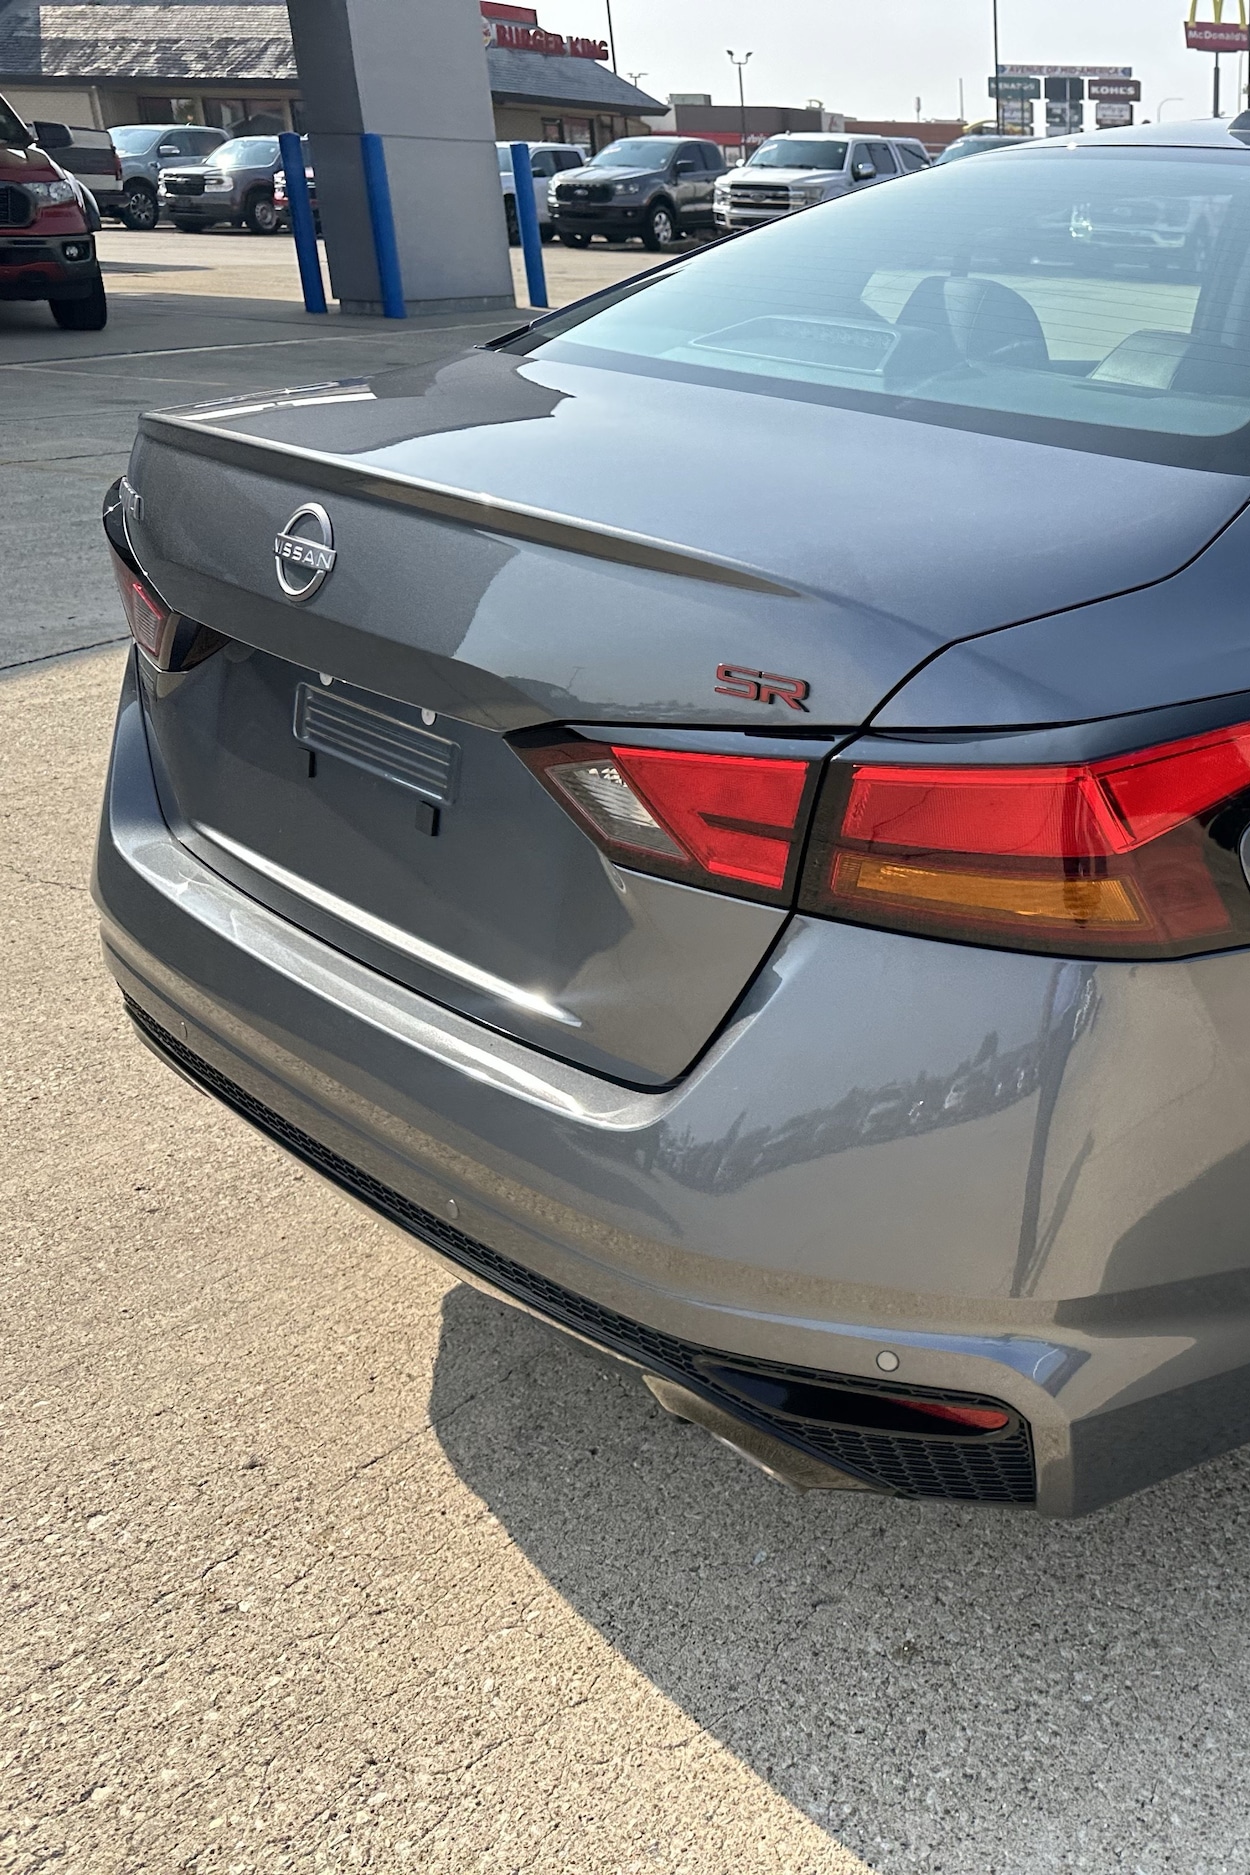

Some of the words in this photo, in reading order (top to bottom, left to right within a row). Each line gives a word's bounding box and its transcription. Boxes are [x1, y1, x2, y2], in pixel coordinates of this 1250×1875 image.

[494, 23, 565, 56] BURGER
[567, 36, 609, 60] KING
[1188, 30, 1248, 41] McDonald's
[714, 663, 810, 712] SR
